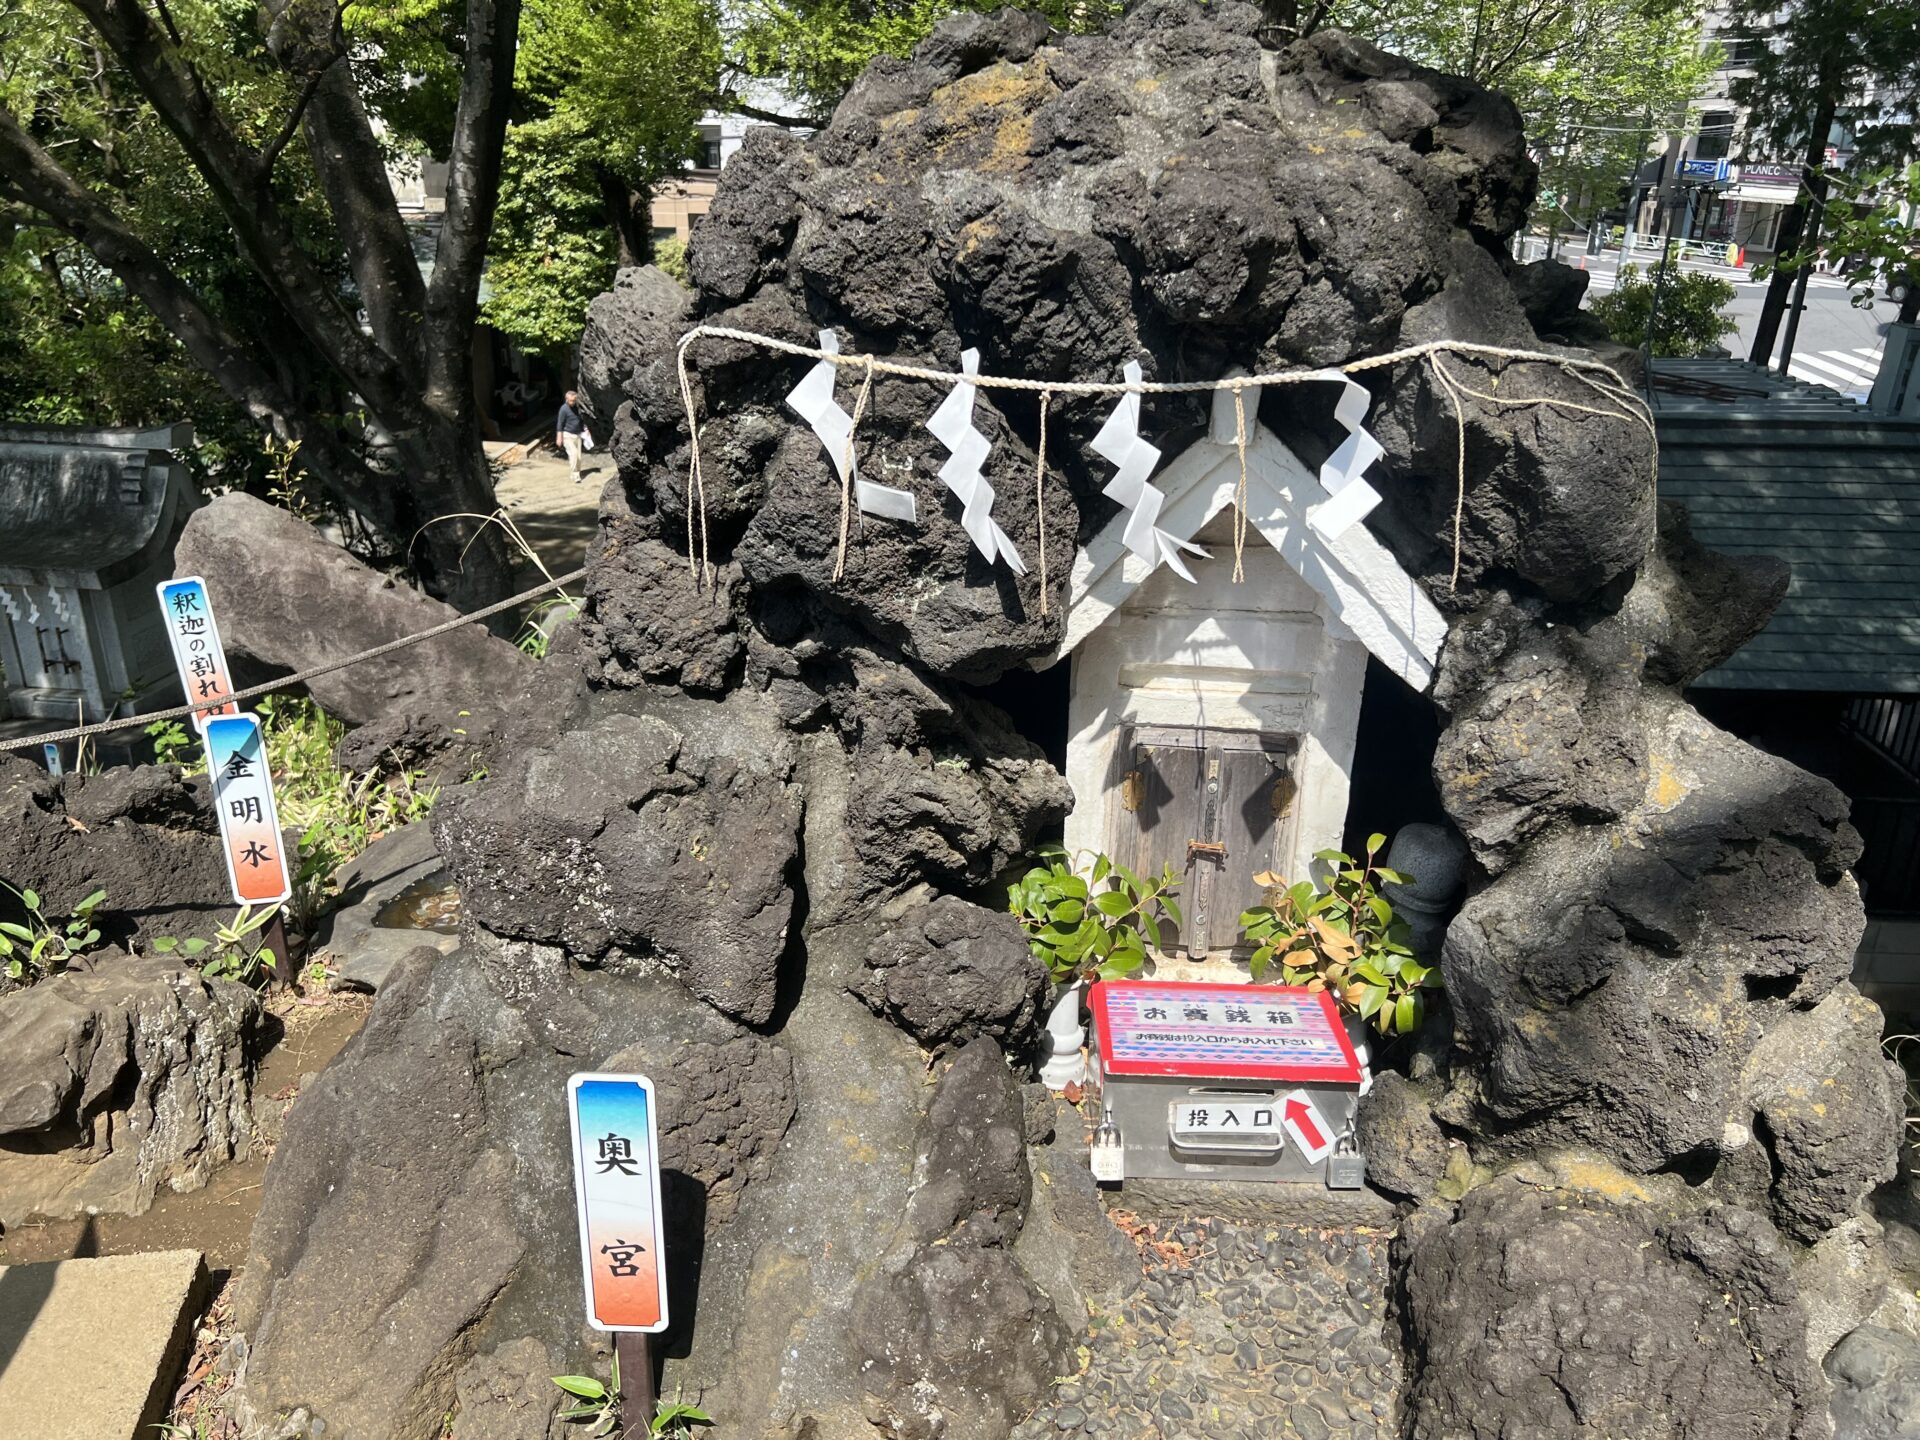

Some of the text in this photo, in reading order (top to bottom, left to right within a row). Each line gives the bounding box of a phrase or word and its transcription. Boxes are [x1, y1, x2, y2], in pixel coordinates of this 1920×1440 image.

[1691, 163, 1717, 172] クリーニン
[222, 750, 273, 868] 金明水
[1135, 1033, 1314, 1046] お賽銭は投入口からお入れ下さい
[1188, 1109, 1272, 1127] 投入口
[594, 1132, 647, 1277] 奥宮
